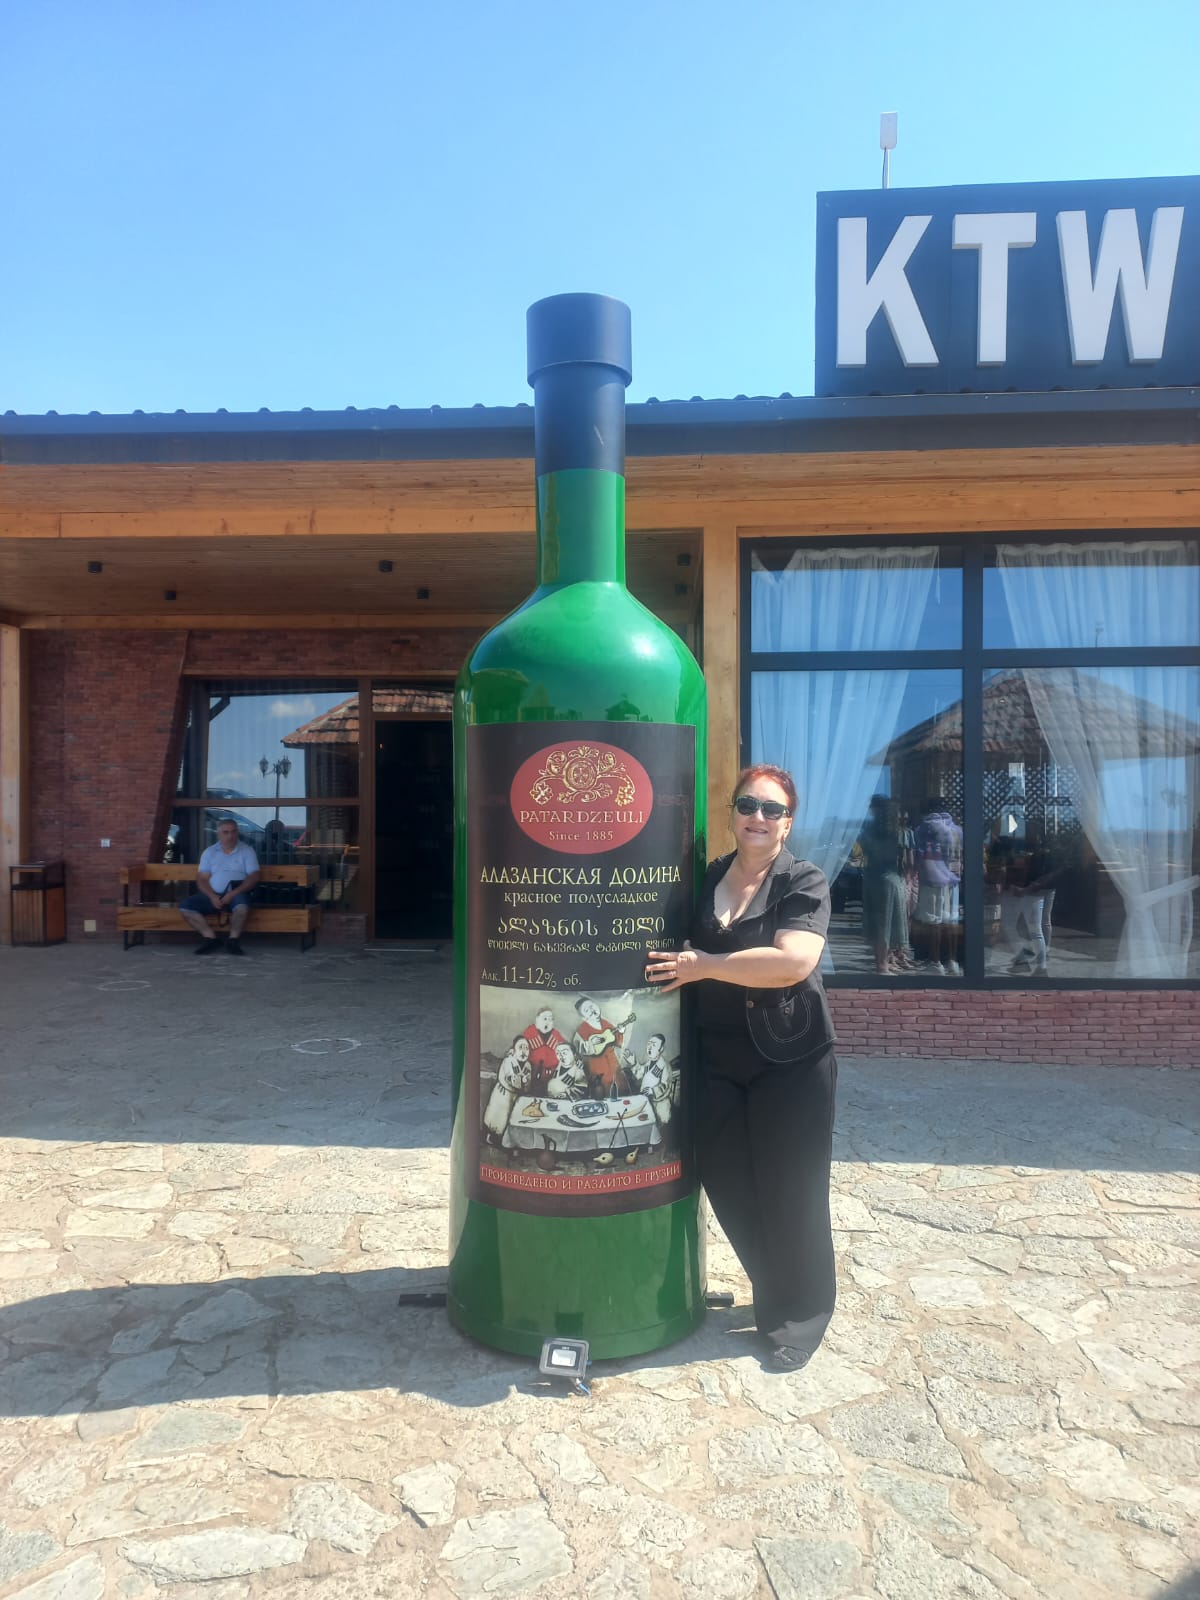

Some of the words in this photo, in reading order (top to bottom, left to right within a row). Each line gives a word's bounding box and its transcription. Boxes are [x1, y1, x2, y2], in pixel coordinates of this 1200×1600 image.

[836, 206, 1185, 368] KTW
[519, 810, 643, 824] PATARDZEULI
[549, 830, 580, 841] Since
[586, 830, 614, 841] 1885
[480, 865, 601, 886] АЛАЗАНСКАЯ
[609, 865, 682, 888] ДОЛИНА
[504, 890, 562, 907] красное
[568, 890, 659, 908] полусладкое
[498, 917, 599, 936] ალაზნის
[611, 916, 665, 935] ველი
[501, 965, 557, 988] 11-12%
[480, 1166, 558, 1190] ПРОИЗВЕДЕНО
[562, 1180, 572, 1190] И
[577, 1175, 631, 1190] РАЗЛИТО
[635, 1174, 642, 1184] В
[645, 1166, 680, 1182] ГРУЗИИ
